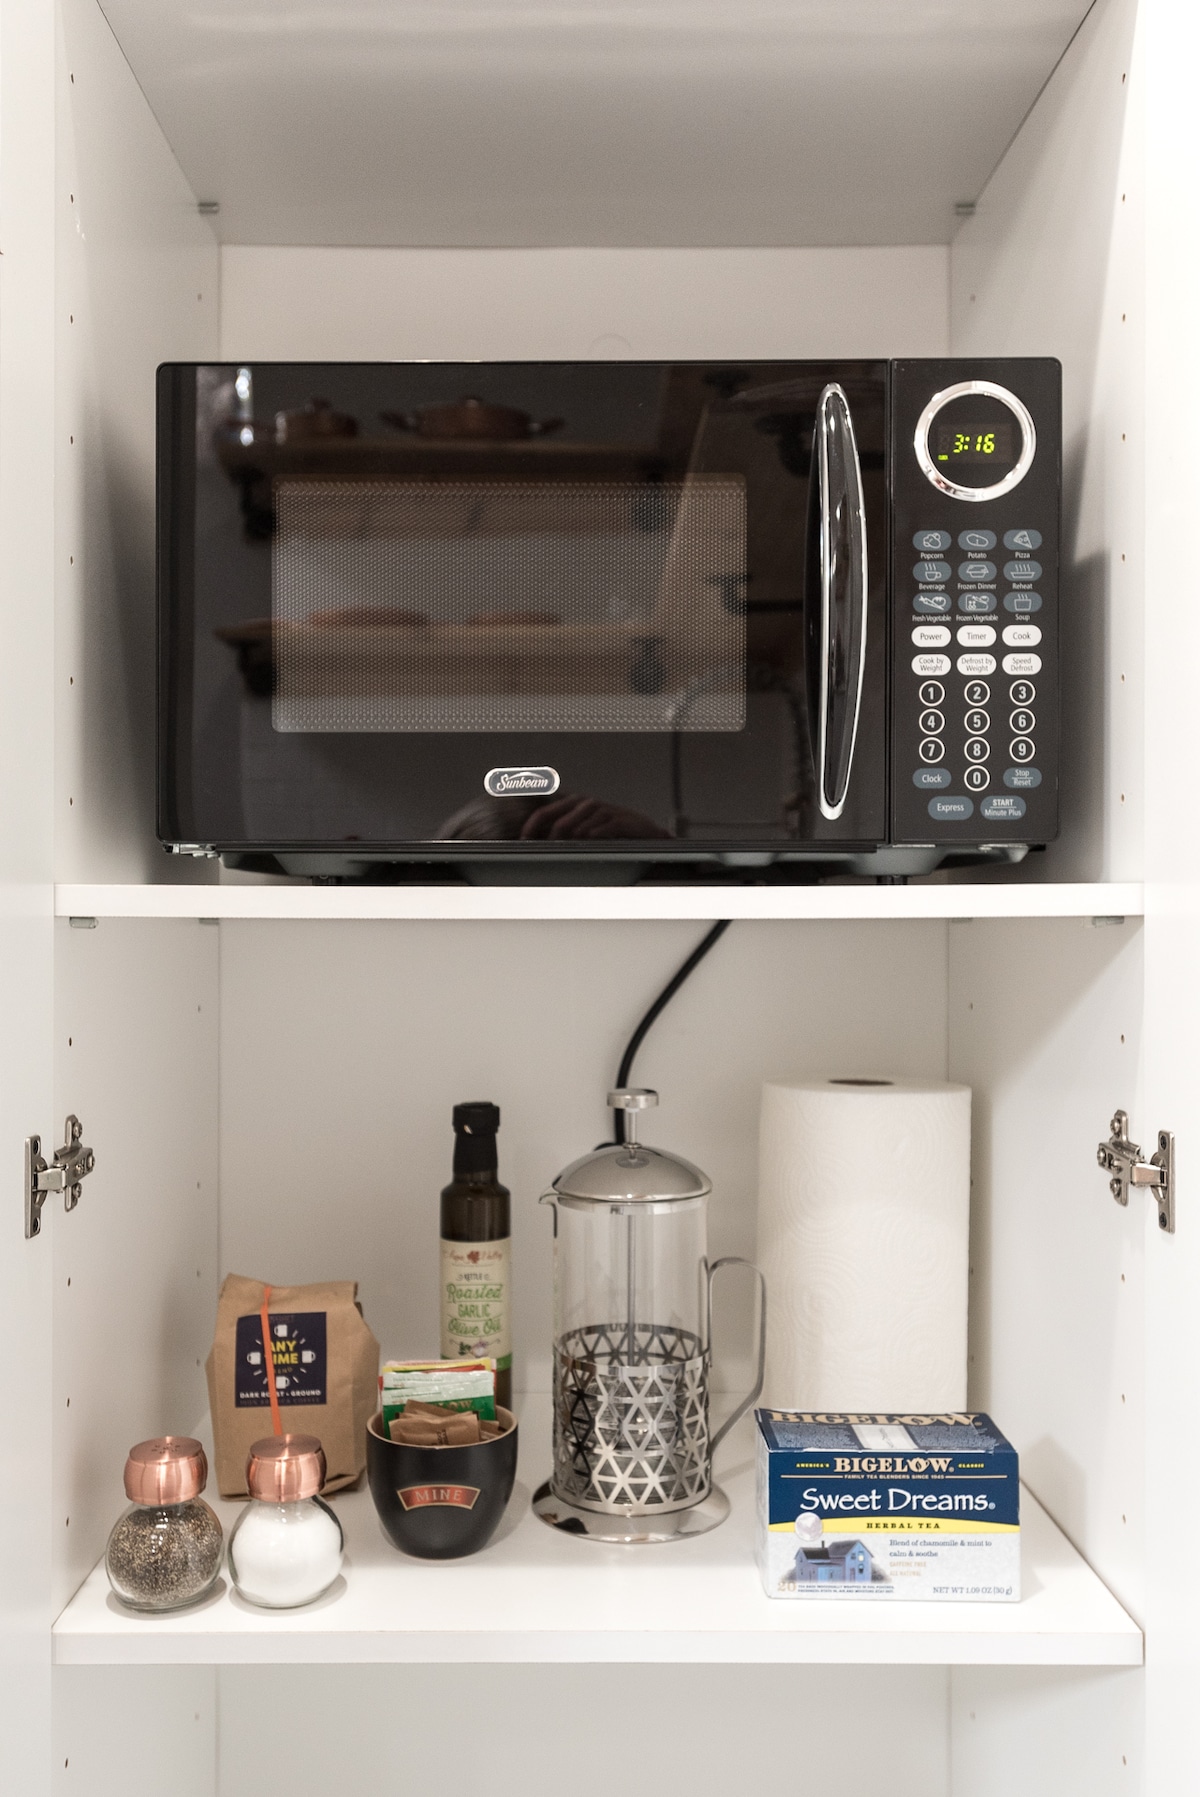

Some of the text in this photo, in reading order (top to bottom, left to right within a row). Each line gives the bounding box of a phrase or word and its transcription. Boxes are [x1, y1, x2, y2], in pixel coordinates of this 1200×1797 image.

[953, 433, 995, 453] 3:16
[1015, 551, 1031, 559] Pizza
[926, 615, 952, 623] Vegetable
[967, 632, 987, 640] Timer
[1012, 632, 1031, 640] Cook
[936, 657, 944, 666] by
[985, 657, 993, 666] by
[1012, 657, 1032, 666] Speed
[920, 665, 943, 673] Weight
[966, 665, 989, 673] Weight
[927, 687, 935, 700] 1
[973, 686, 981, 699] 2
[1018, 686, 1027, 699] 3
[927, 715, 935, 728] 4
[973, 715, 981, 728] 5
[1018, 715, 1026, 728] 6
[927, 744, 935, 757] 7
[973, 743, 981, 756] 8
[1018, 743, 1026, 756] 9
[922, 774, 942, 783] Clock
[972, 772, 981, 785] 0
[1014, 769, 1030, 778] Stop
[496, 773, 548, 791] Sunbeam
[937, 803, 964, 813] Express
[447, 1283, 503, 1303] Roasted
[458, 1304, 491, 1318] GARLIC
[448, 1318, 480, 1336] Olive
[266, 1353, 299, 1365] IME
[768, 1411, 979, 1426] BIGELOW
[833, 1457, 953, 1473] BIGELOW
[415, 1489, 463, 1501] MINE
[800, 1488, 988, 1510] Sweet Dreams
[993, 1586, 1004, 1594] (30
[1005, 1587, 1013, 1595] g)
